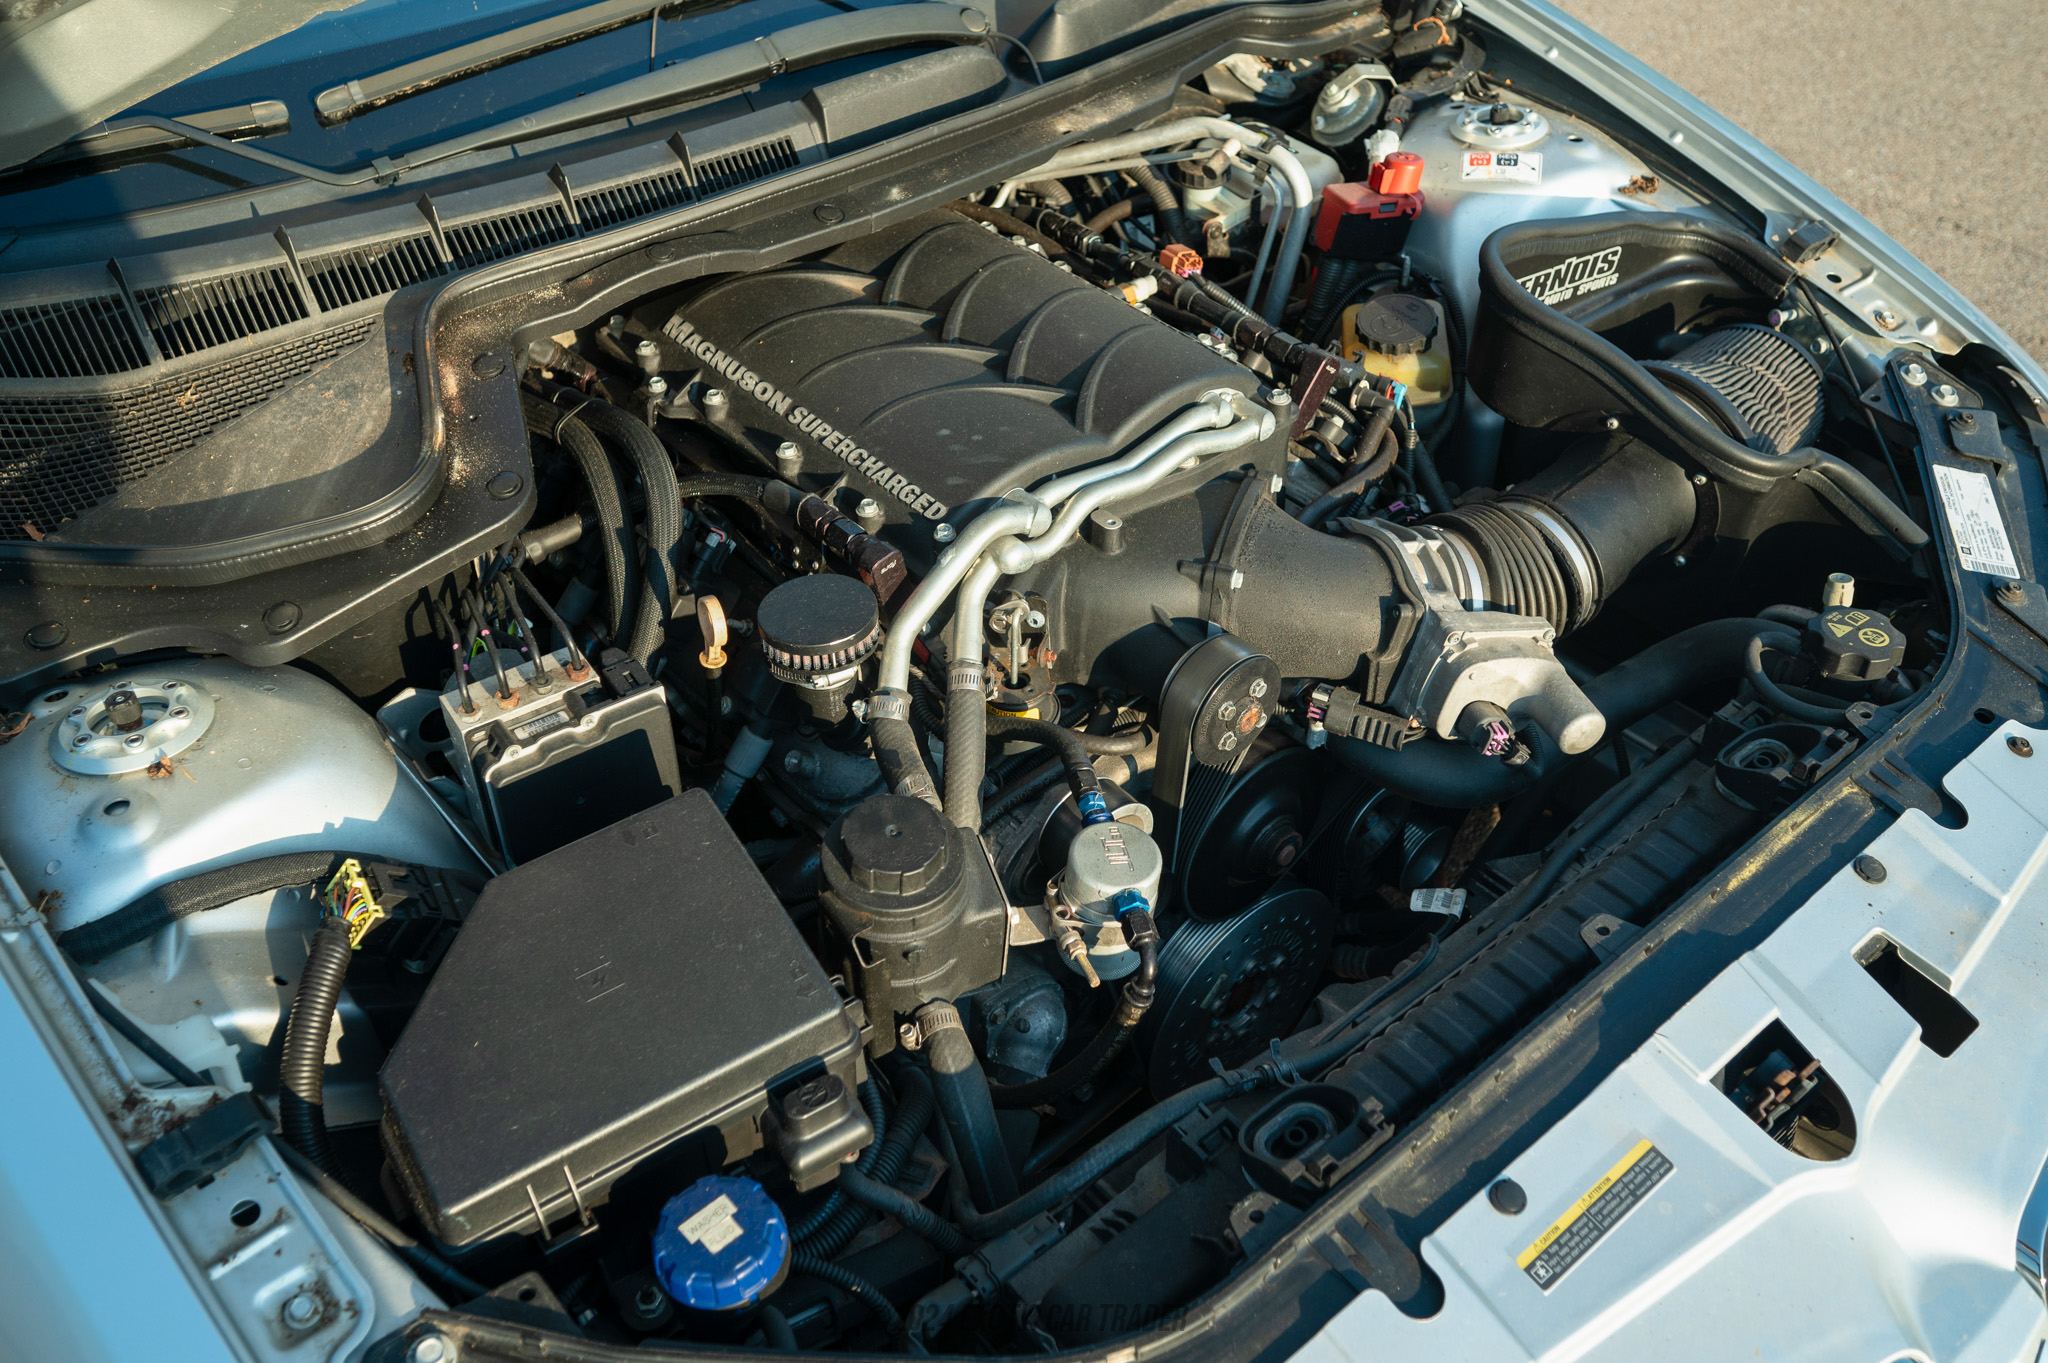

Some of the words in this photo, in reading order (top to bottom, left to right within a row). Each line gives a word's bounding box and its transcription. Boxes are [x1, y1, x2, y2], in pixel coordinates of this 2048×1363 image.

[1577, 273, 1619, 296] SPORTS
[662, 314, 793, 416] MAGNUSON
[787, 406, 950, 521] SUPERCHARGED
[1588, 1177, 1612, 1200] ATTENTION
[687, 1203, 728, 1236] WASHER
[707, 1224, 736, 1246] FLUID
[1540, 1225, 1560, 1245] CAUTION
